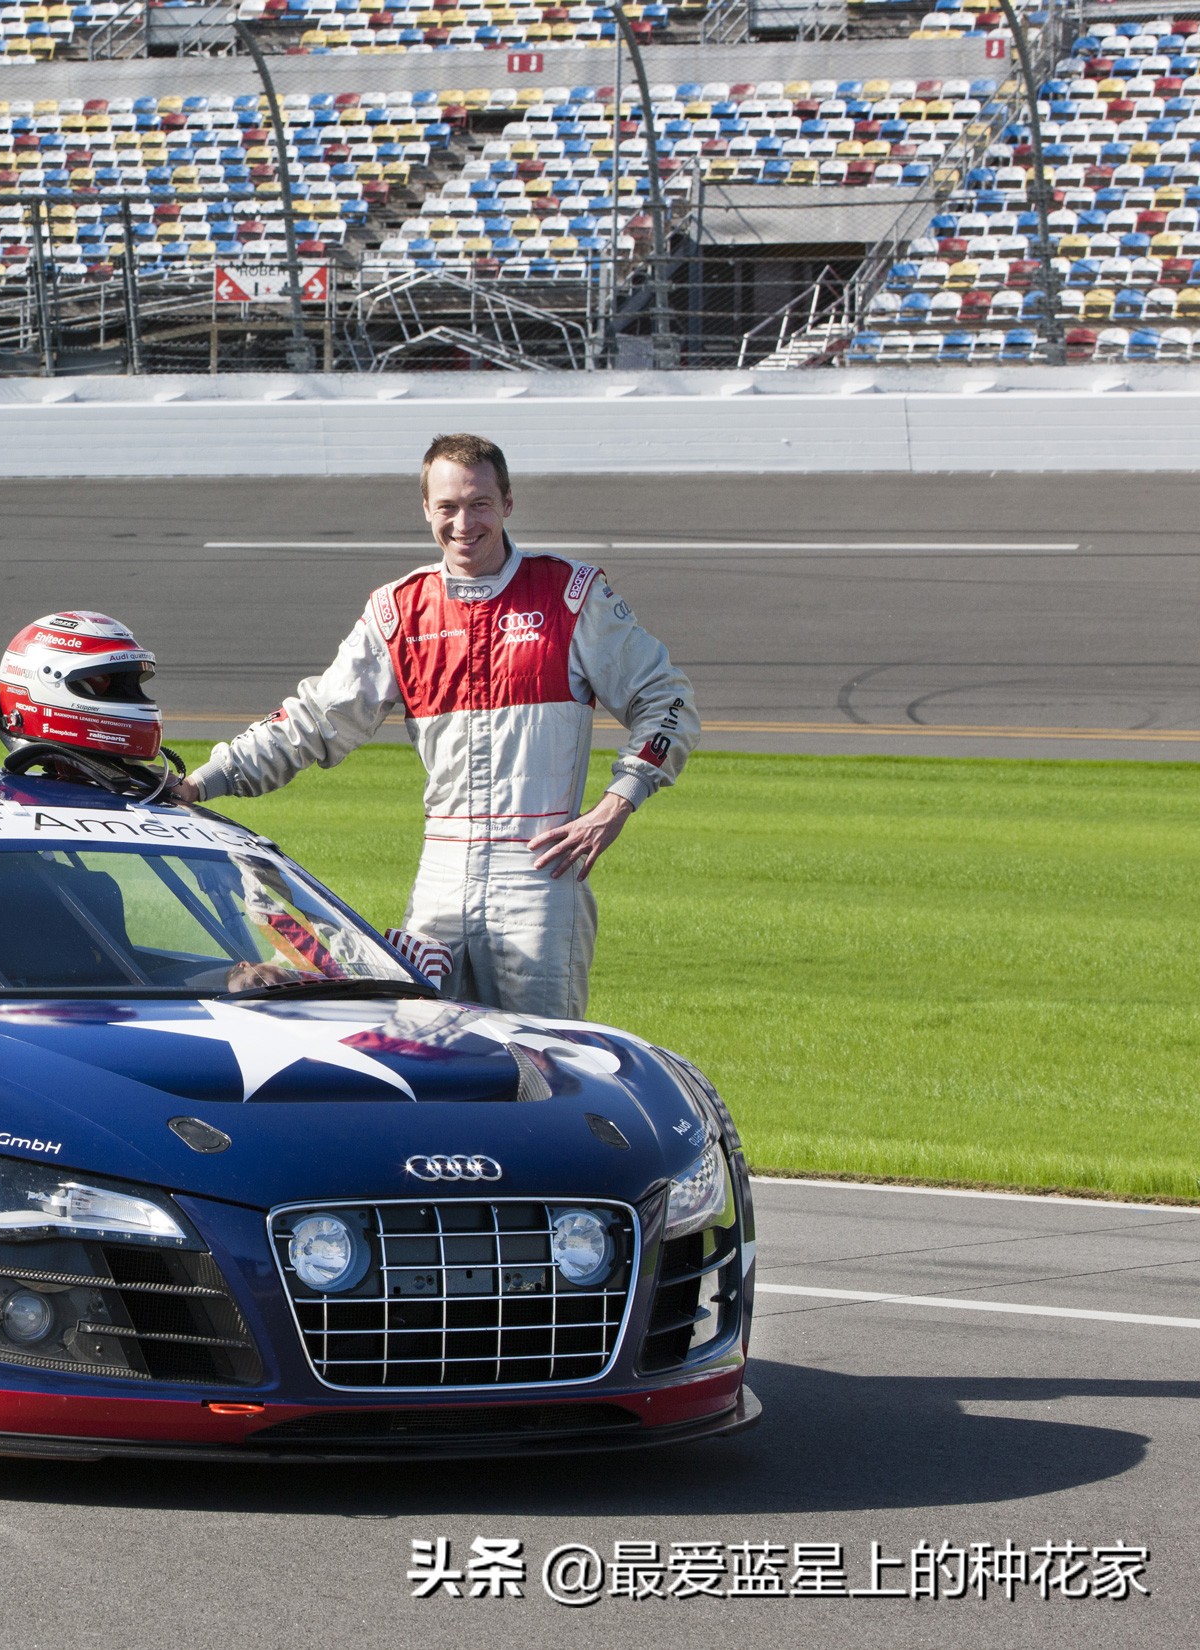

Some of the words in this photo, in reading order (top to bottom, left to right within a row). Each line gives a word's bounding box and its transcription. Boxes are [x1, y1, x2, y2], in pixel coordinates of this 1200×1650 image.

[33, 631, 82, 648] Eniteo.de
[405, 632, 439, 645] quattro
[440, 628, 467, 639] GmbH
[505, 630, 540, 644] Audi
[109, 653, 129, 662] Audi
[671, 1118, 693, 1136] Audi
